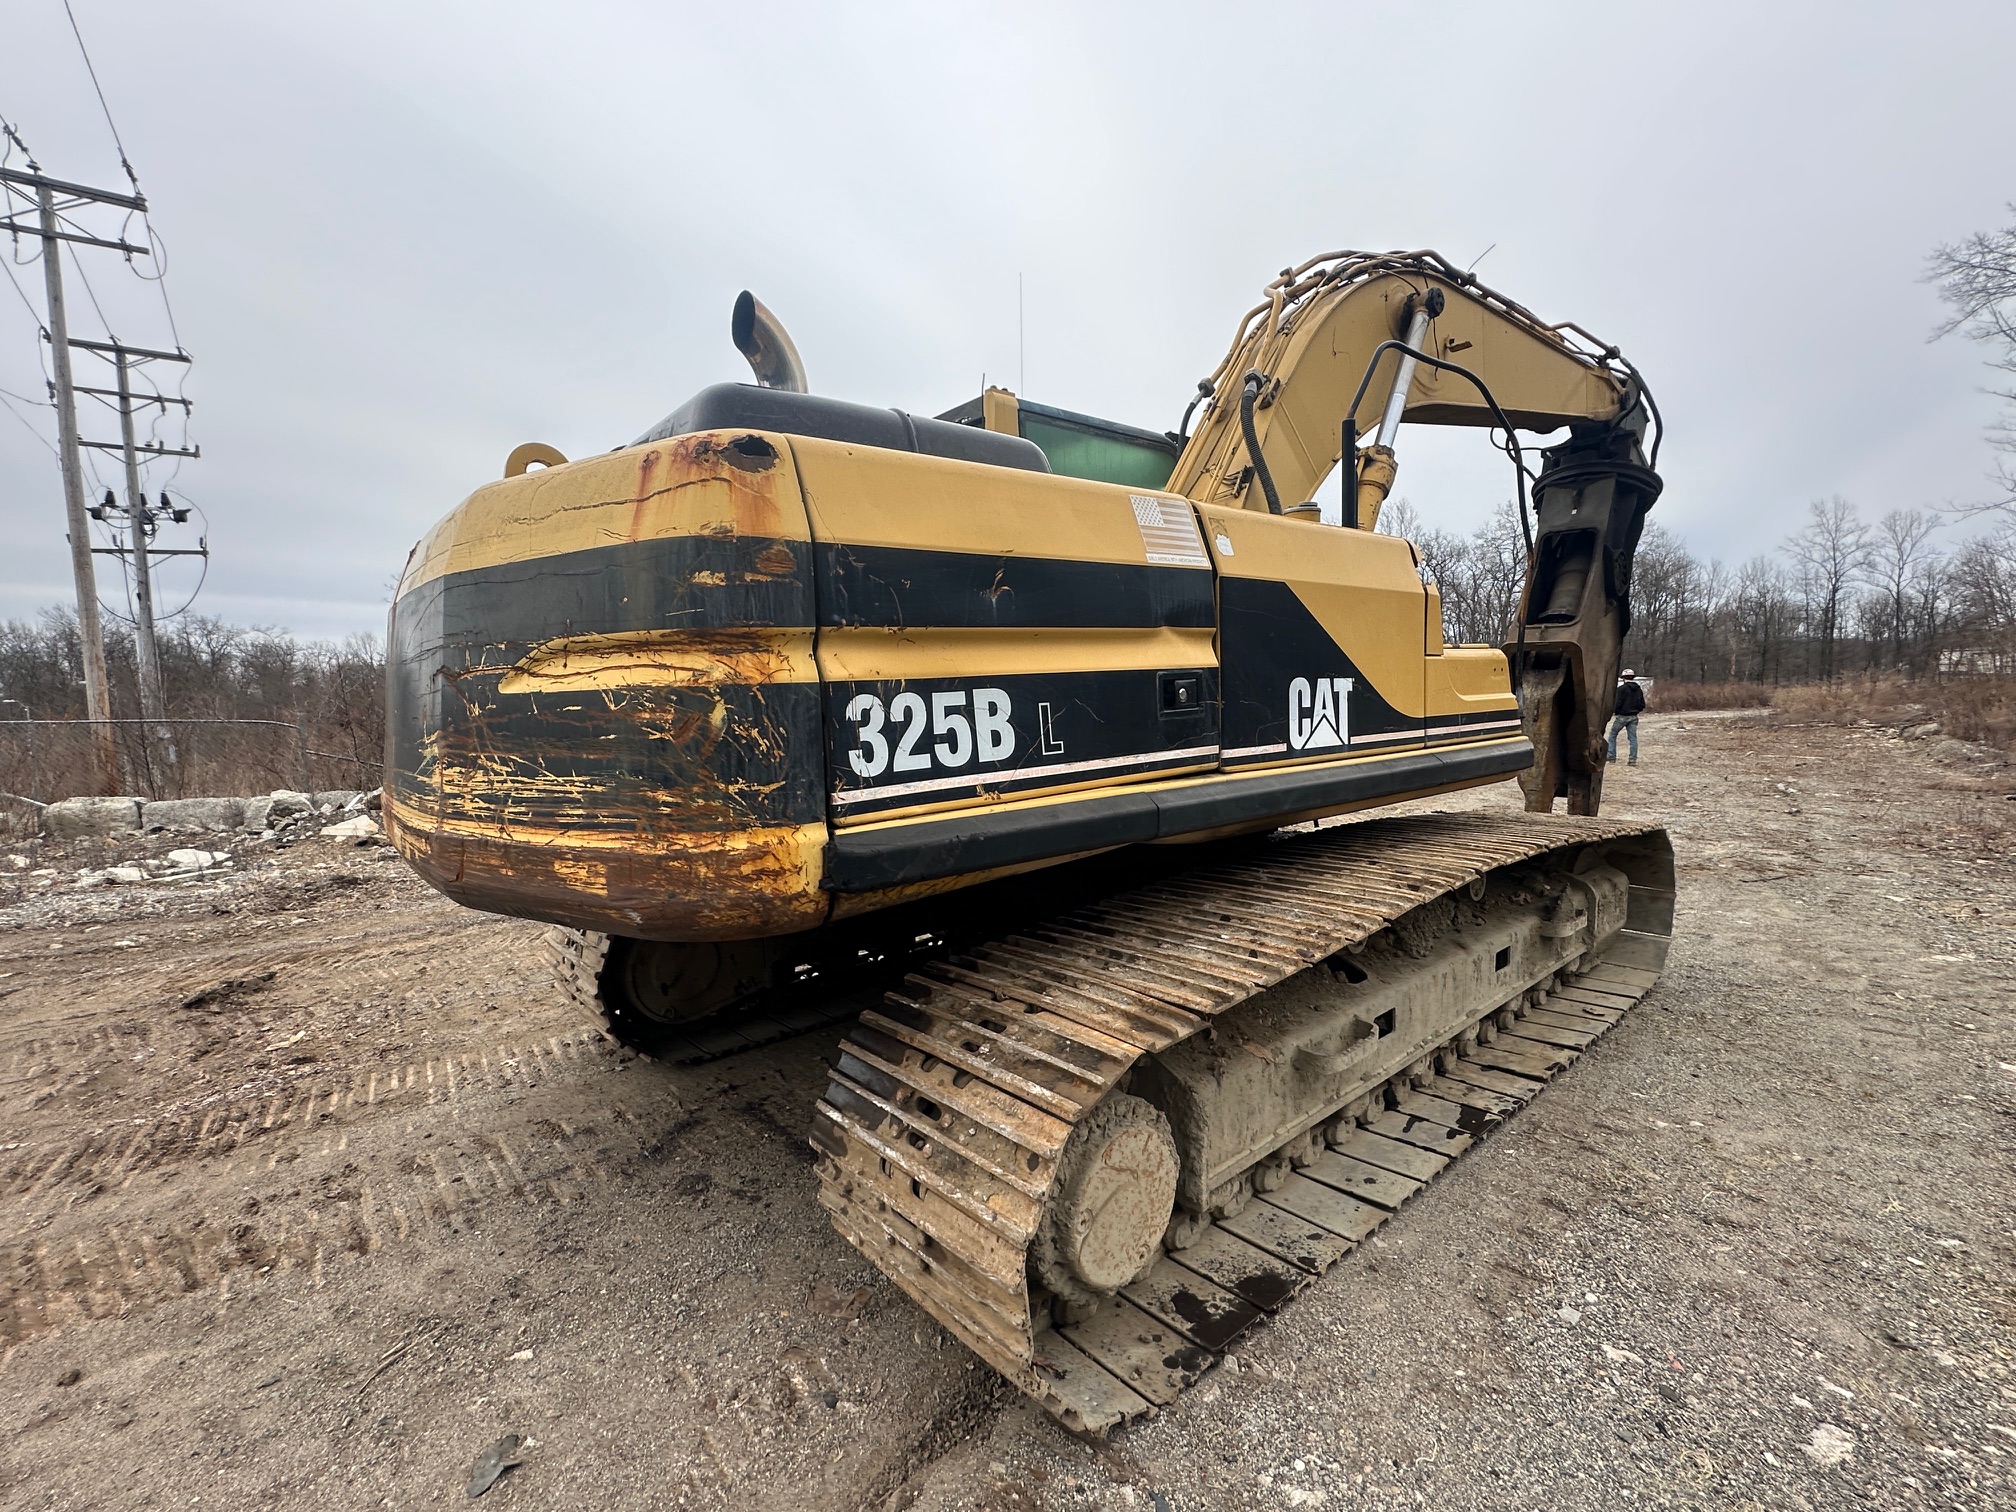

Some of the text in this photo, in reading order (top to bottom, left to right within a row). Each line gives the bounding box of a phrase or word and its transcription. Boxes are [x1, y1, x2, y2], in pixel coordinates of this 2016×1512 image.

[846, 688, 1064, 777] 325B L
[1289, 677, 1353, 749] CAT
